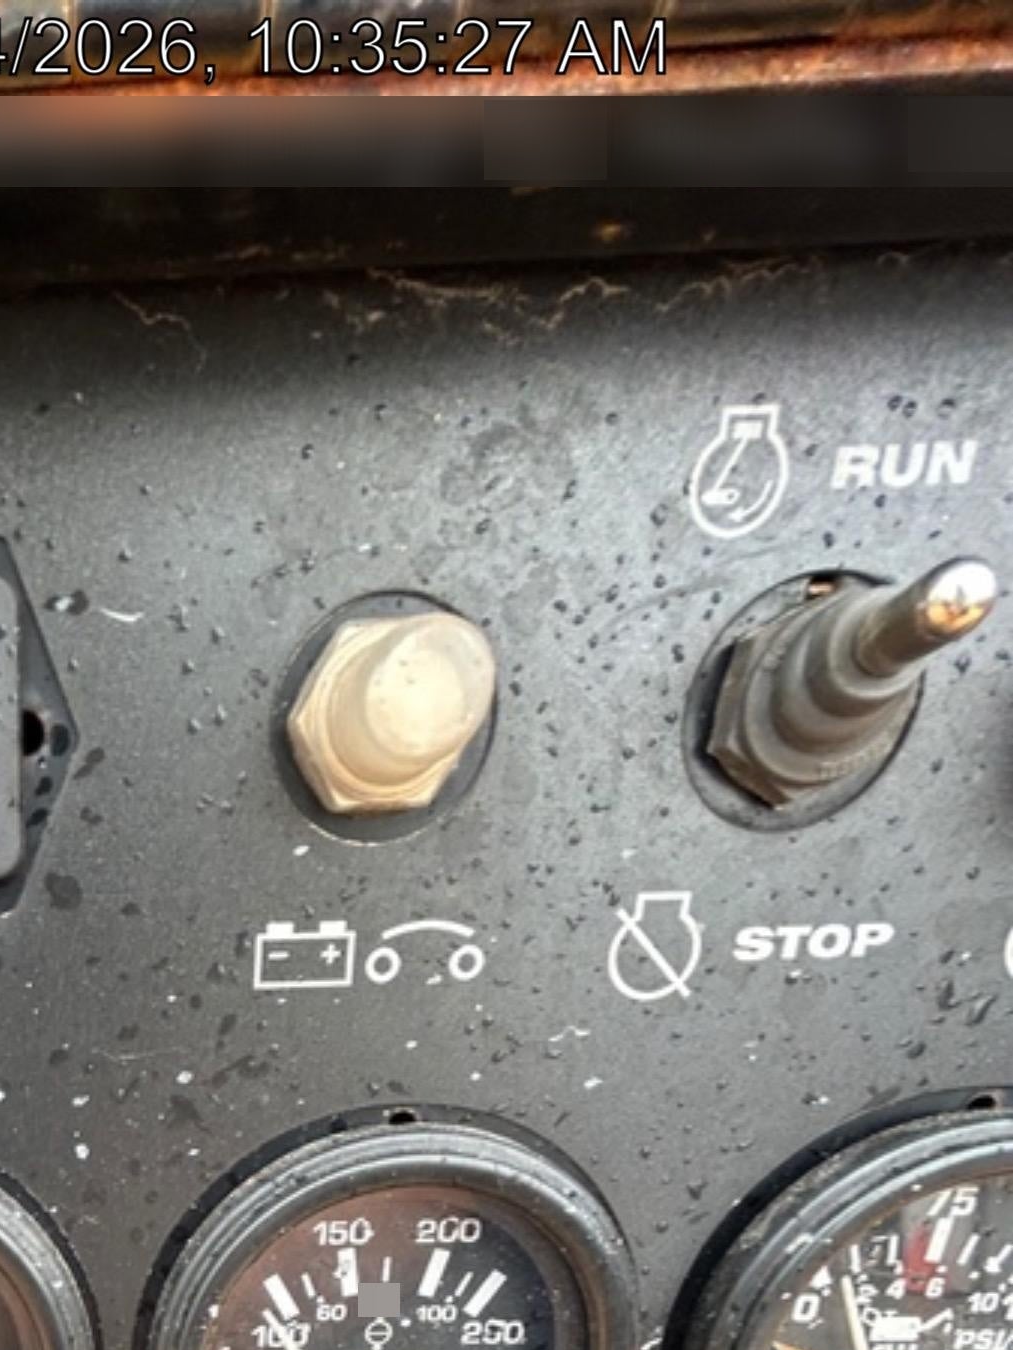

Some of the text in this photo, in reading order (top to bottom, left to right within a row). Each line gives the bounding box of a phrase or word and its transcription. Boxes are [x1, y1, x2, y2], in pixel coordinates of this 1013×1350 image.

[830, 441, 978, 489] RUN
[733, 924, 894, 961] STOP
[313, 1219, 375, 1246] 150
[415, 1217, 482, 1243] 200
[886, 1277, 907, 1300] 4
[926, 1277, 945, 1298] 6
[417, 1304, 457, 1323] 100
[792, 1292, 821, 1322] 0
[968, 1292, 999, 1314] 10
